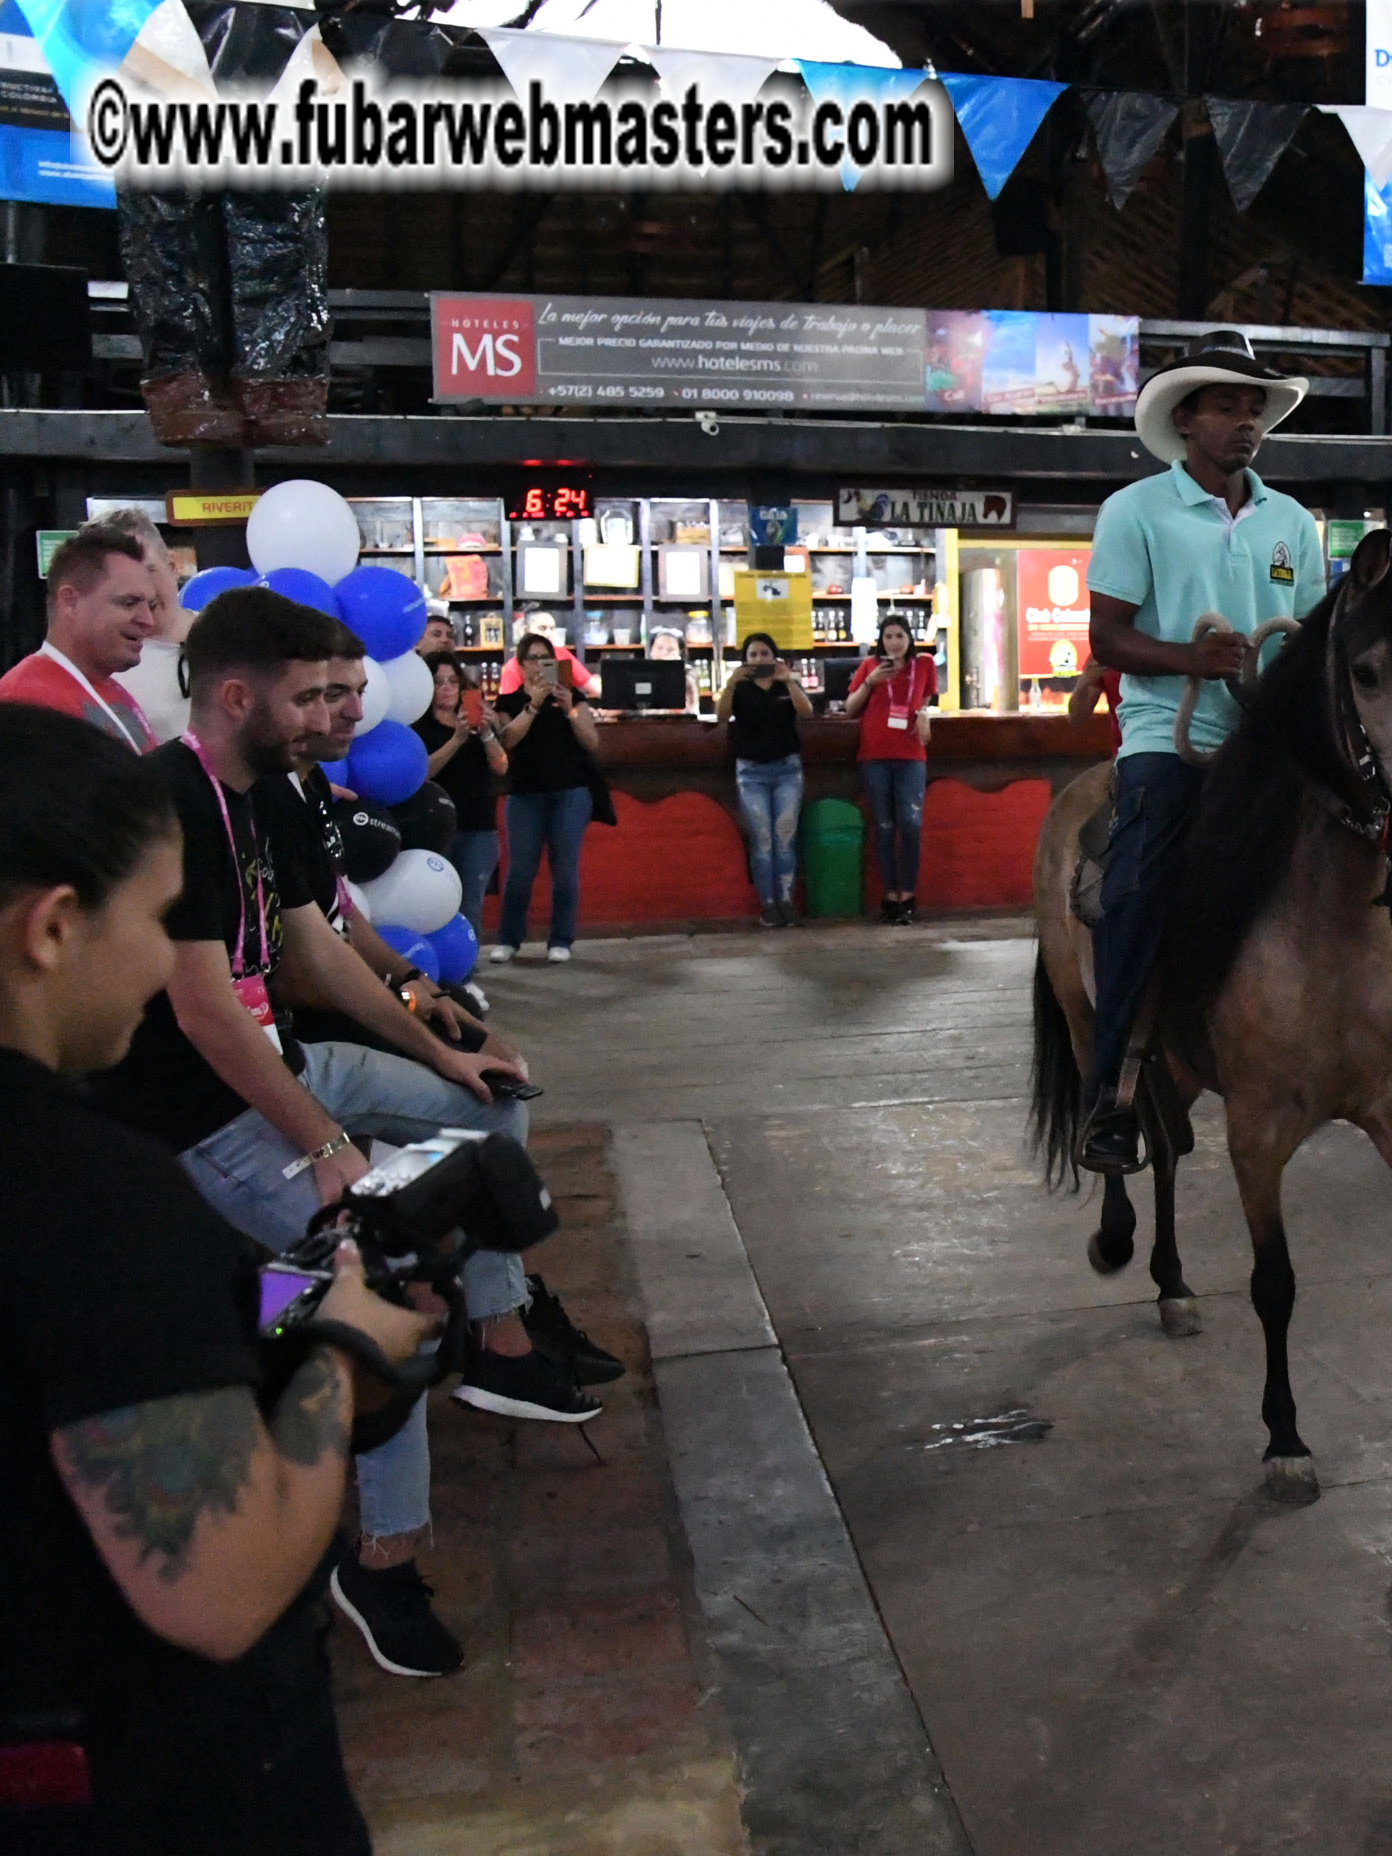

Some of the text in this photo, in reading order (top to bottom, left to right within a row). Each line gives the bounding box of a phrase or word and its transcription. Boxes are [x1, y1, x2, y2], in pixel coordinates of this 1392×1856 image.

[451, 318, 520, 330] HOTELES
[538, 302, 557, 325] La
[561, 309, 607, 331] mejor
[611, 310, 661, 332] opción
[660, 315, 700, 333] para
[732, 315, 776, 337] viajes
[780, 312, 799, 330] de
[803, 313, 858, 339] trabajo
[869, 317, 922, 340] placer
[451, 332, 522, 377] MS
[558, 336, 594, 346] MEJOR
[639, 338, 713, 349] GARANTIZADO
[716, 340, 738, 350] POR
[740, 341, 775, 351] MEDIO
[776, 342, 791, 352] DE
[793, 343, 840, 354] NUESTRA
[880, 346, 904, 356] WEB
[651, 353, 818, 373] www.hotelesms.com
[548, 385, 794, 402] +57(2) 485 5259 01 8000 910098
[525, 487, 586, 513] 6:24
[912, 490, 957, 502] TIENDA
[202, 500, 254, 513] RIVERIT
[890, 501, 980, 524] LA TINAJA
